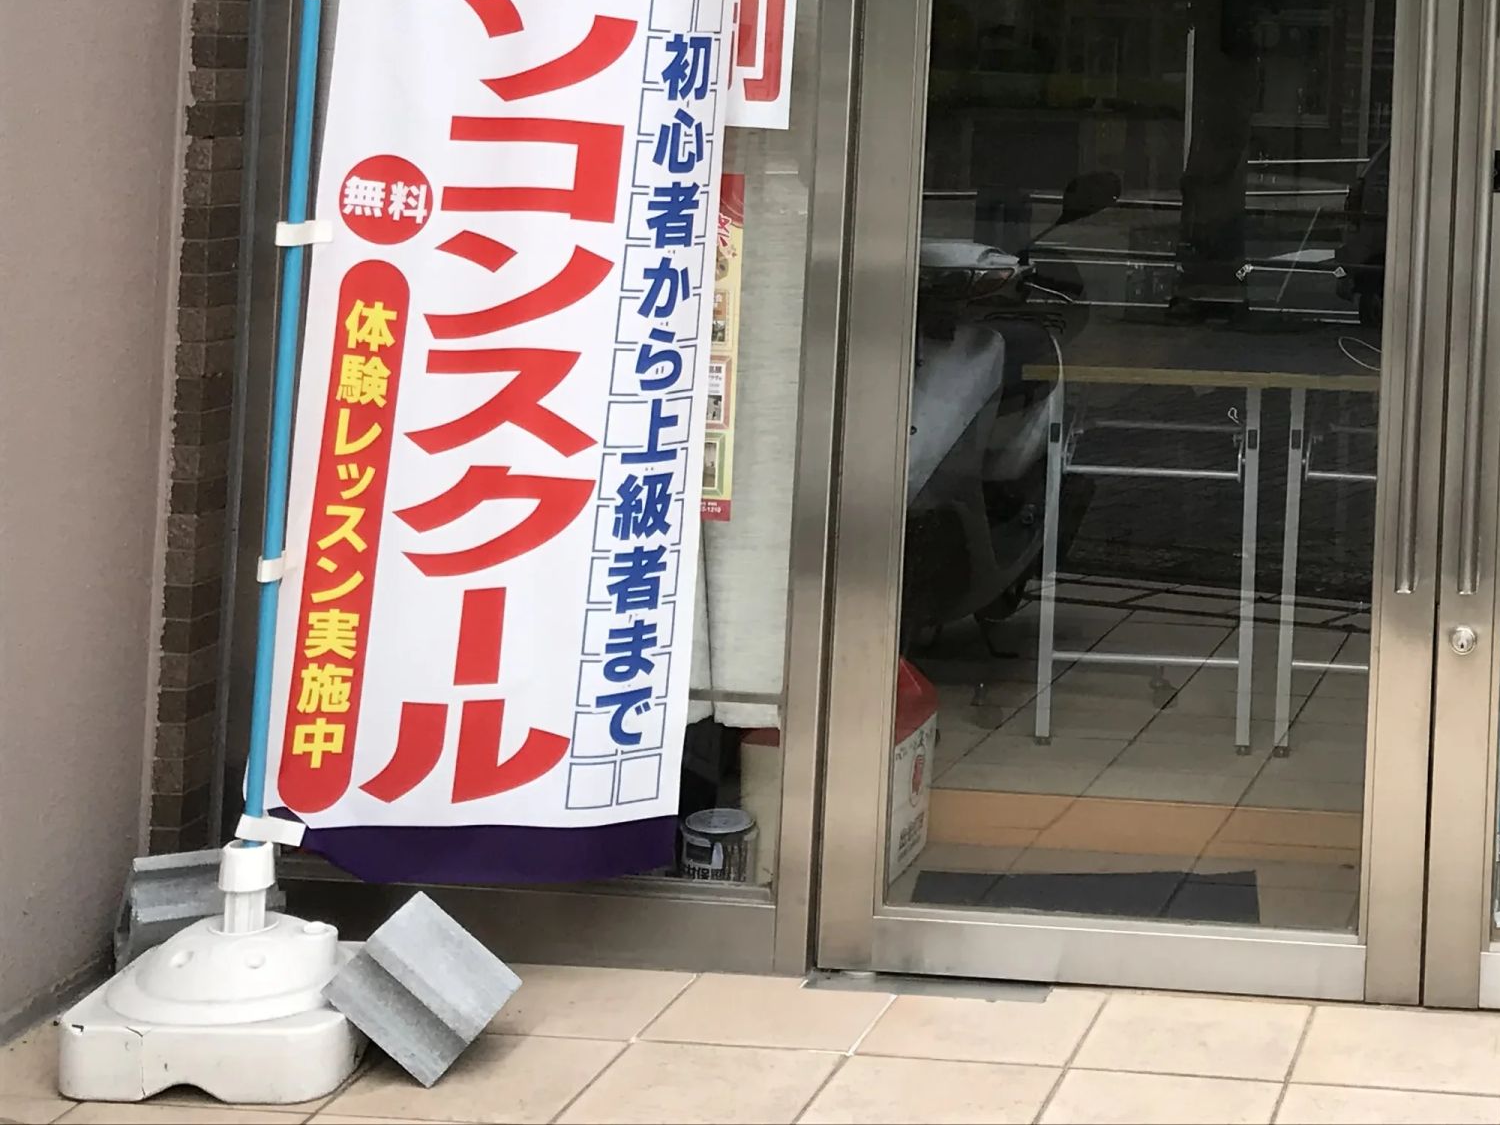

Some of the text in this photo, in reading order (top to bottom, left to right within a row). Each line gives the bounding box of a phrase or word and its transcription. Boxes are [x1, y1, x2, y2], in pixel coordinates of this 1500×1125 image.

[341, 175, 428, 223] 無料
[602, 33, 711, 746] 初心者から上級者まで
[291, 300, 396, 771] 体験レッスン実施中
